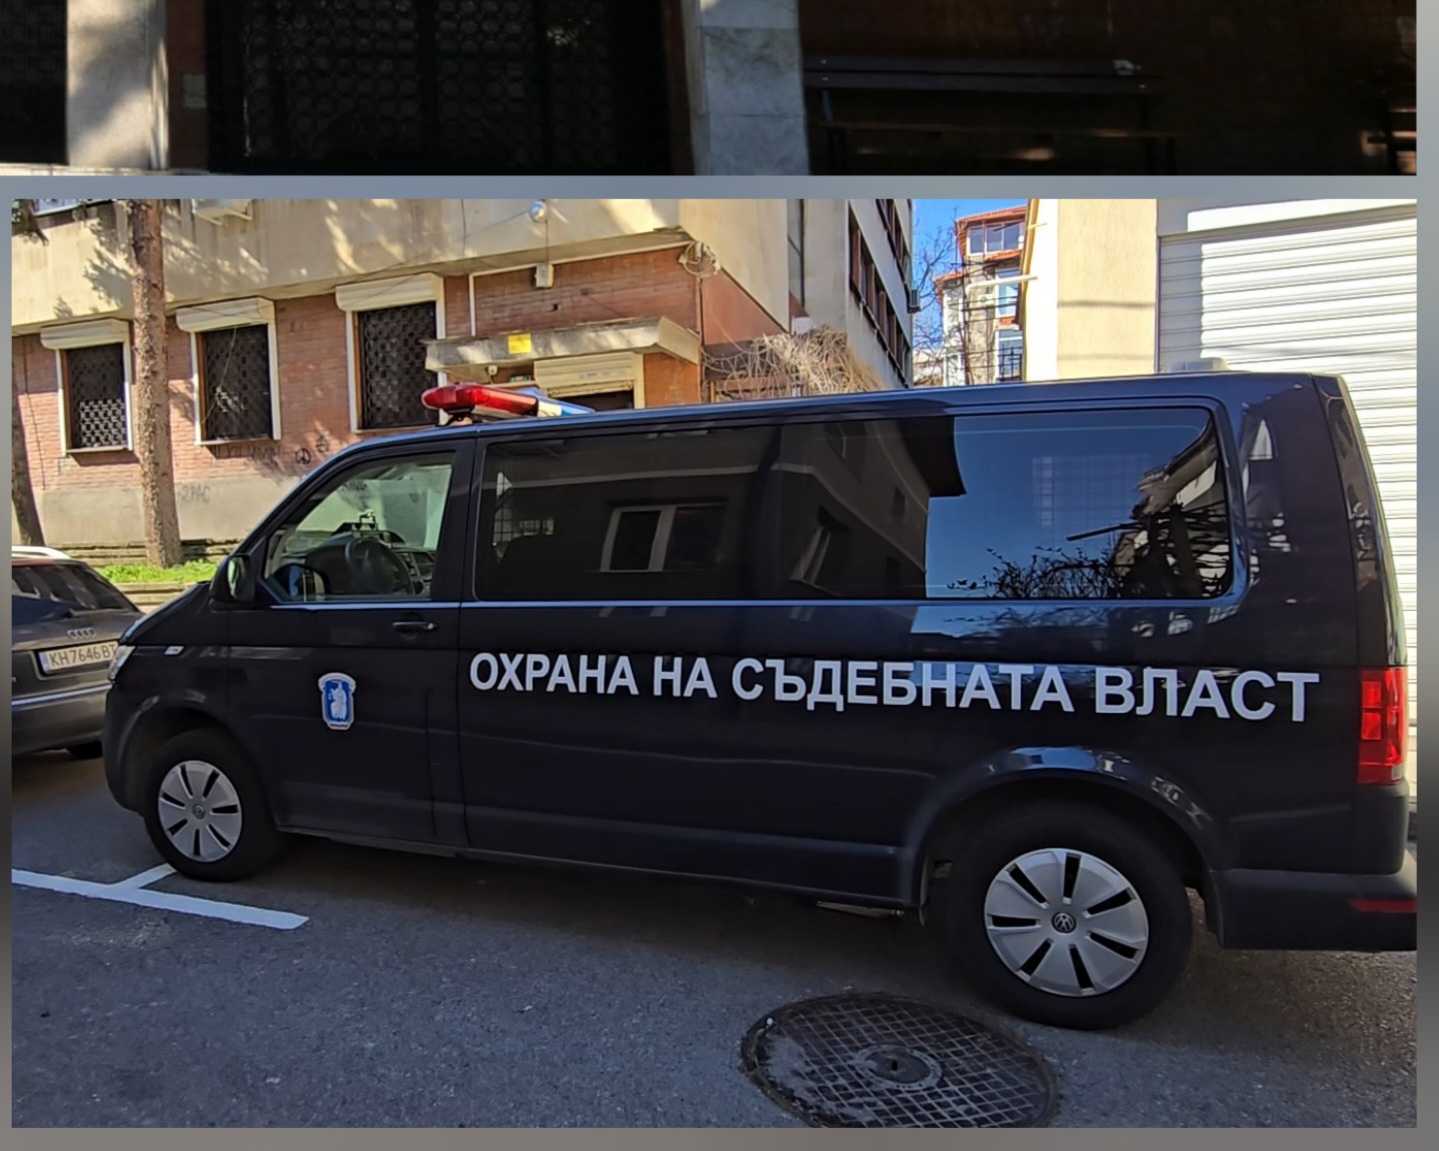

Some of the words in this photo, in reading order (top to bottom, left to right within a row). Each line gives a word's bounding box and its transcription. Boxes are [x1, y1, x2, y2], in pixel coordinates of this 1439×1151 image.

[468, 652, 640, 696] ОХРАНА
[652, 655, 719, 699] НА
[731, 657, 1076, 713] СЪДЕБНАТА
[1094, 665, 1321, 723] ВЛАСТ
